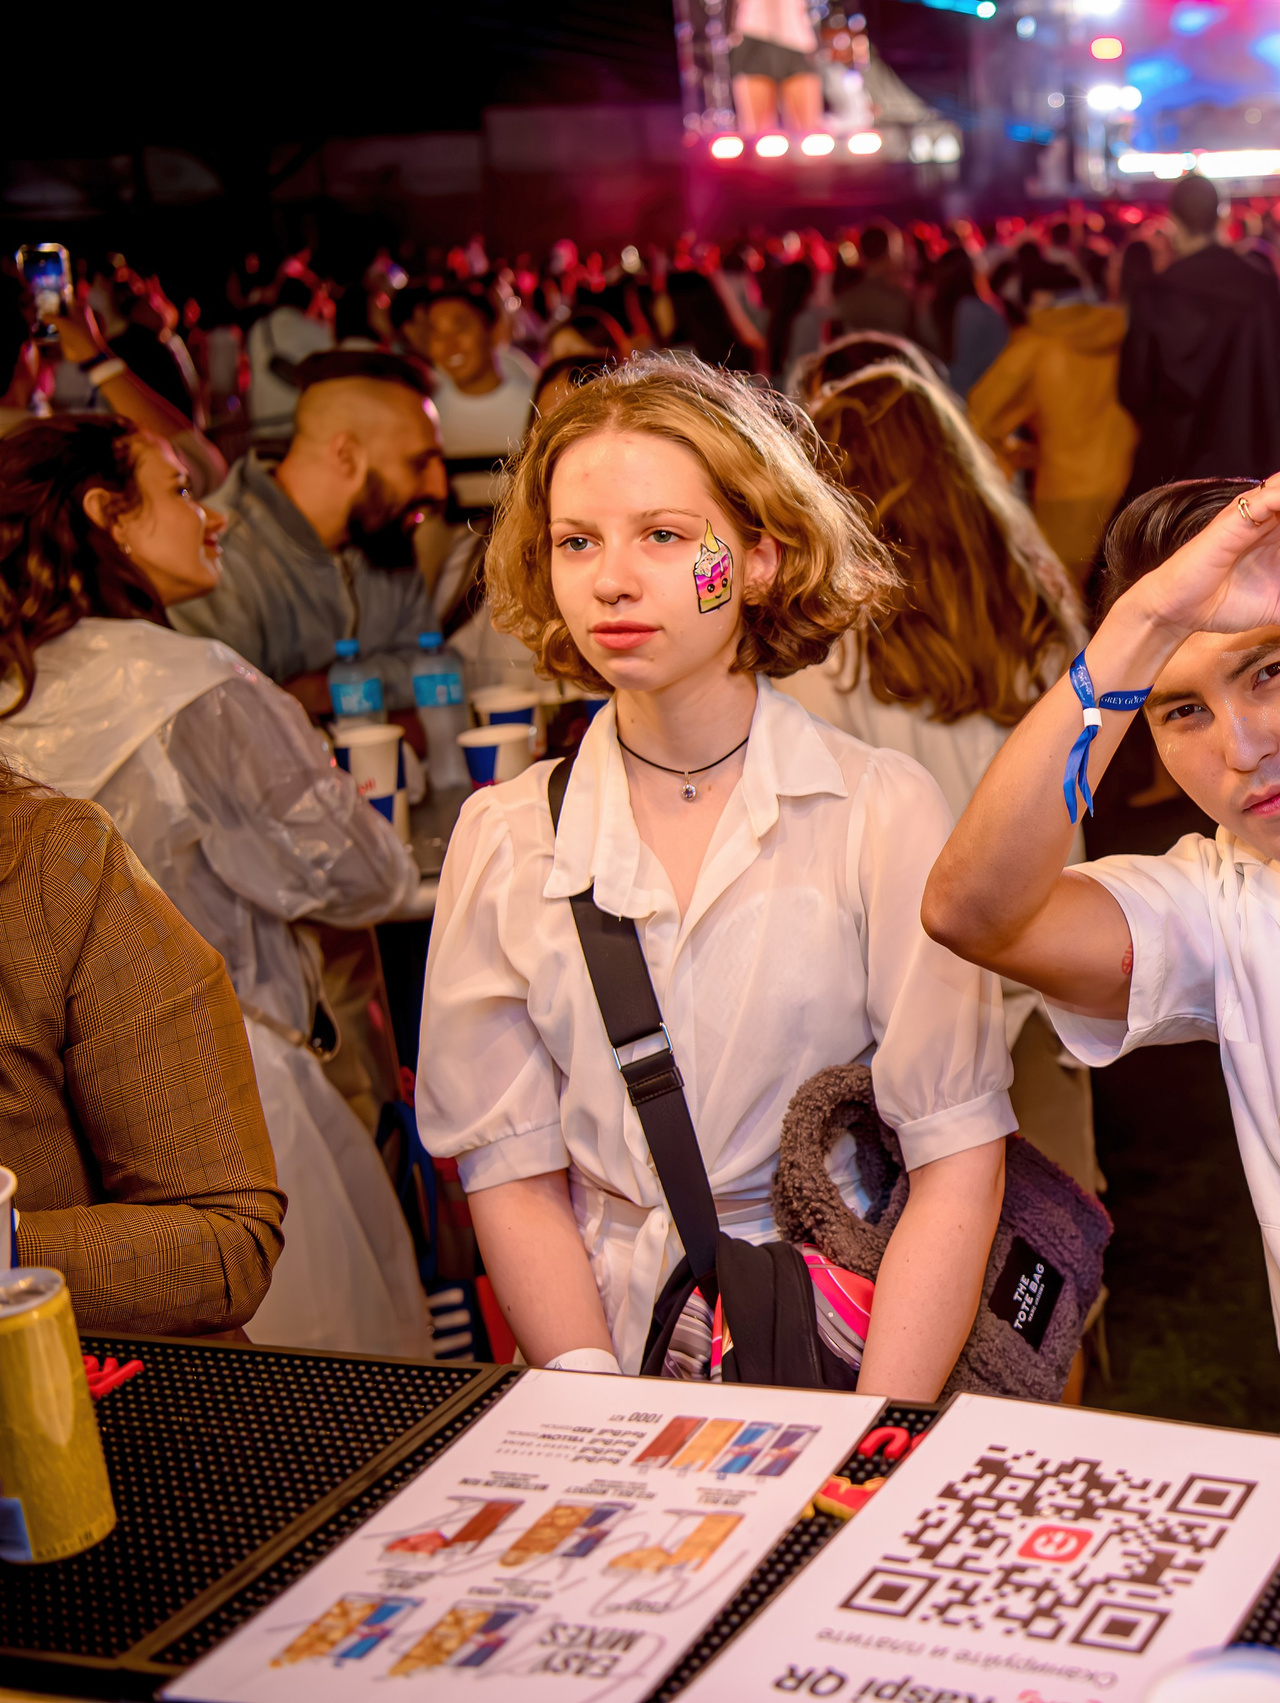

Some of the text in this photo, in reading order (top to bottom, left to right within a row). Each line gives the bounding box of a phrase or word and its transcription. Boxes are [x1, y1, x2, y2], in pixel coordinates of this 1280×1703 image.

[1013, 1274, 1030, 1302] THE
[1013, 1262, 1045, 1330] TOTE BAG
[627, 1412, 663, 1424] 1000
[538, 1433, 586, 1443] YELLOW
[537, 1623, 646, 1654] MIXES
[815, 1627, 926, 1657] платите
[929, 1646, 949, 1658] и
[538, 1653, 619, 1680] EASY
[772, 1664, 848, 1698] QR
